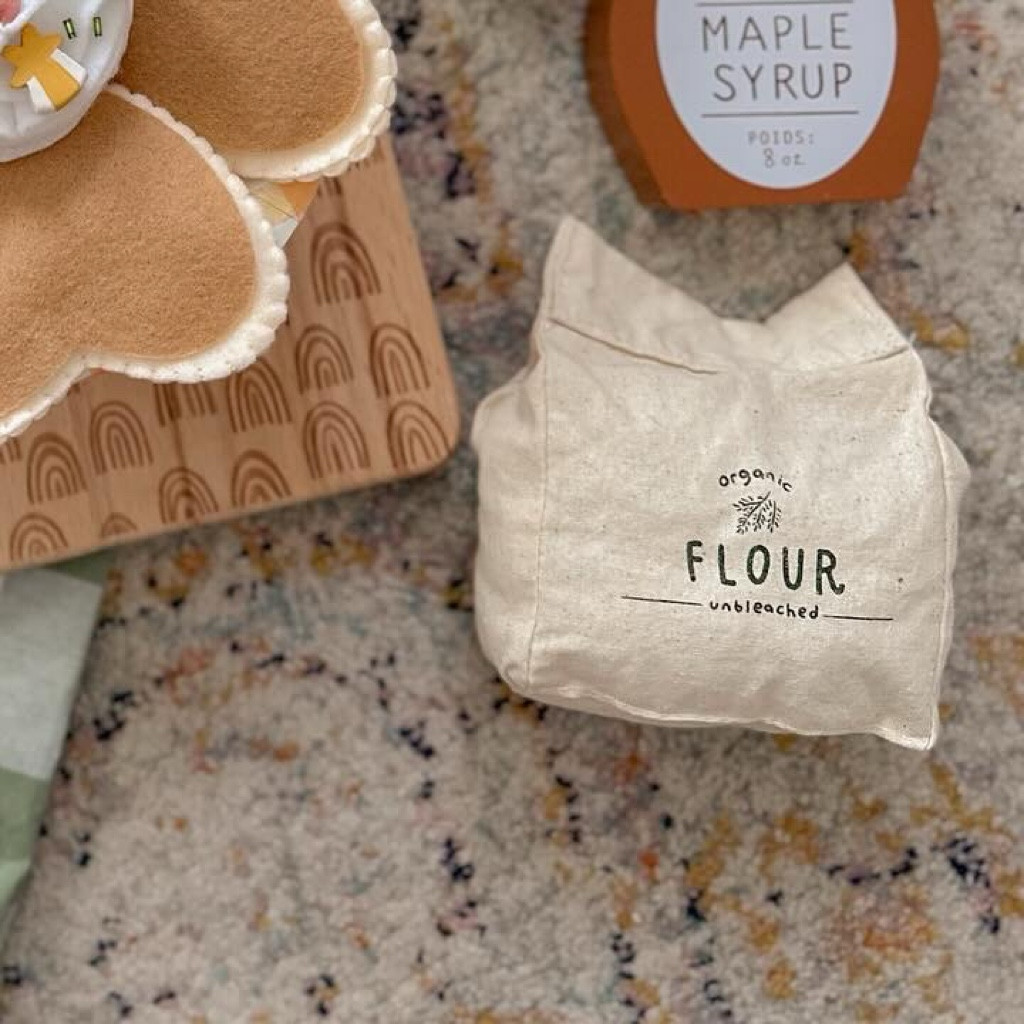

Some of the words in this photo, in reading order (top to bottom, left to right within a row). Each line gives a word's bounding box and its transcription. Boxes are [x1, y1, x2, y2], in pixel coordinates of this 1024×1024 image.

[701, 13, 852, 52] MAPLE
[713, 63, 853, 102] SYRUP
[747, 129, 815, 145] POIDS:
[763, 147, 775, 169] 8
[719, 468, 792, 492] organic
[686, 540, 845, 595] FLOUR
[709, 600, 819, 619] unbleached
